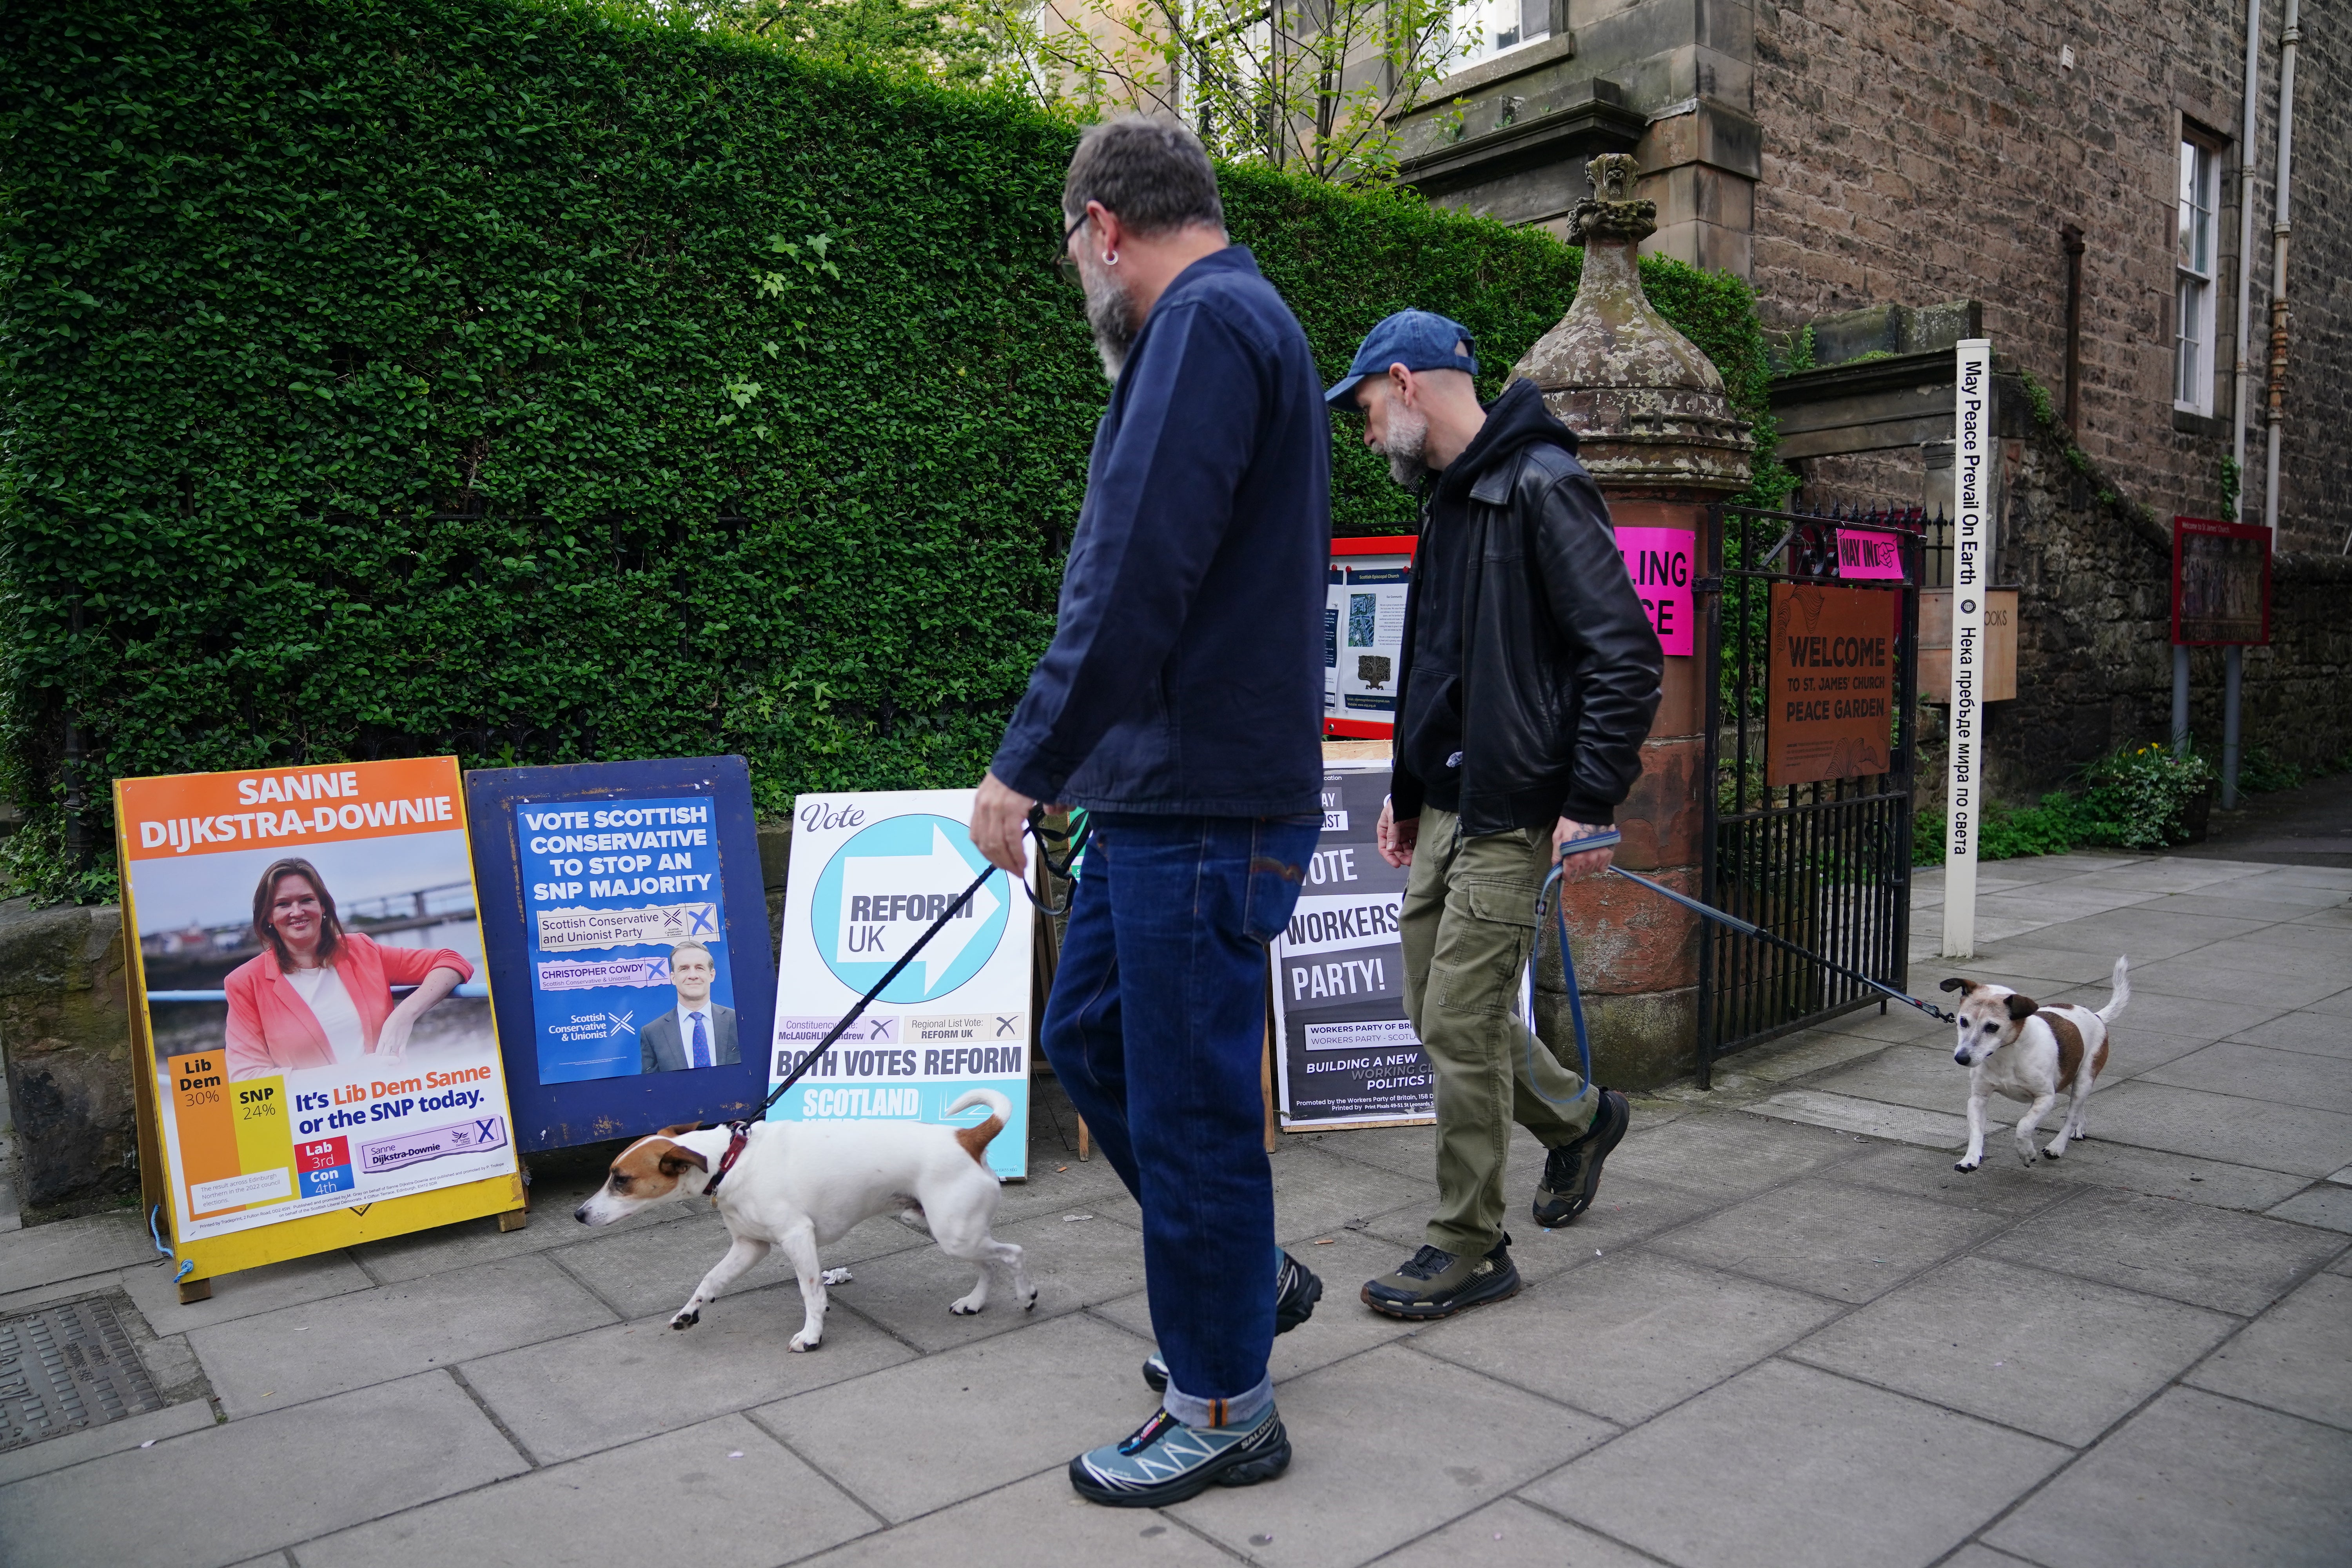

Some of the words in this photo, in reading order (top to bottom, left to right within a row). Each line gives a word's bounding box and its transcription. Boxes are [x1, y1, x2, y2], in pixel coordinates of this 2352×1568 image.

[1962, 361, 1982, 395] May
[1964, 400, 1981, 450] Peace
[1963, 455, 1980, 509] Prevail
[1962, 514, 1979, 536] On
[1840, 538, 1860, 566] WAY
[1863, 540, 1875, 567] IN
[1960, 541, 1978, 585] Earth
[1984, 610, 2007, 626] OOKS
[1788, 636, 1886, 668] WELCOME
[1960, 628, 1976, 665] Нека
[1788, 678, 1799, 692] TO
[1802, 677, 1815, 691] ST.
[1818, 677, 1849, 691] JAMES'
[1852, 676, 1886, 690] CHURCH
[1786, 701, 1829, 722] PEACE
[1834, 698, 1885, 719] GARDEN
[1956, 670, 1975, 739] пребъде
[1953, 744, 1969, 782] мира
[238, 771, 358, 805] SANNE
[1956, 788, 1968, 807] по
[140, 796, 452, 853] DIJKSTRA-DOWNIE
[525, 811, 589, 830] VOTE
[594, 806, 707, 828] SCOTTISH
[800, 802, 866, 832] Vote
[530, 828, 707, 854] CONSERVATIVE
[1954, 813, 1967, 855] света
[550, 858, 583, 877] TO
[589, 855, 652, 875] STOP
[657, 852, 692, 871] AN
[1302, 849, 1357, 886] OTE
[534, 881, 583, 901] SNP
[590, 873, 711, 898] MAJORITY
[851, 893, 974, 922] REFORM
[542, 918, 585, 930] Scottish
[589, 913, 659, 927] Conservative
[1286, 903, 1399, 945] WORKERS
[543, 933, 564, 944] and
[568, 929, 612, 942] Unionist
[615, 927, 642, 940] Party
[848, 925, 886, 953] UK
[542, 967, 607, 979] CHRISTOPHER
[610, 964, 644, 974] COWDY
[1292, 958, 1385, 1000] PARTY!
[548, 1023, 606, 1034] Conservative
[571, 1013, 605, 1023] Scottish
[786, 1020, 836, 1031] Constituency
[911, 1019, 946, 1029] Regional
[948, 1018, 962, 1027] List
[963, 1018, 984, 1027] Vote:
[571, 1031, 607, 1041] Unionist
[921, 1030, 959, 1039] REFORM
[961, 1029, 973, 1038] UK
[185, 1059, 211, 1074] Lib
[777, 1051, 838, 1076] BOTH
[844, 1049, 916, 1076] VOTES
[924, 1046, 1021, 1075] REFORM
[1307, 1058, 1370, 1074] BUILDING
[1373, 1056, 1383, 1067] A
[1387, 1053, 1417, 1065] NEW
[1352, 1065, 1415, 1080] WORKING
[1367, 1074, 1425, 1090] POLITICS
[180, 1076, 221, 1091] Dem
[296, 1092, 329, 1112] It's
[334, 1084, 367, 1105] Lib
[371, 1077, 421, 1099] Dem
[426, 1066, 491, 1089] Sanne
[185, 1089, 220, 1107] 30%
[240, 1087, 274, 1104] SNP
[803, 1088, 919, 1116] SCOTLAND
[243, 1103, 275, 1120] 24%
[299, 1118, 323, 1134] or
[328, 1110, 366, 1129] the
[370, 1098, 414, 1121] SNP
[418, 1089, 485, 1112] today.
[306, 1142, 332, 1156] Lab
[371, 1144, 395, 1155] Sanne
[372, 1143, 440, 1164] Dijkstra-Downie
[312, 1155, 334, 1169] 3rd
[249, 1173, 277, 1183] Edinburgh
[310, 1169, 339, 1183] Con
[202, 1191, 228, 1200] Northern
[315, 1181, 336, 1194] 4th
[203, 1198, 229, 1207] elections.
